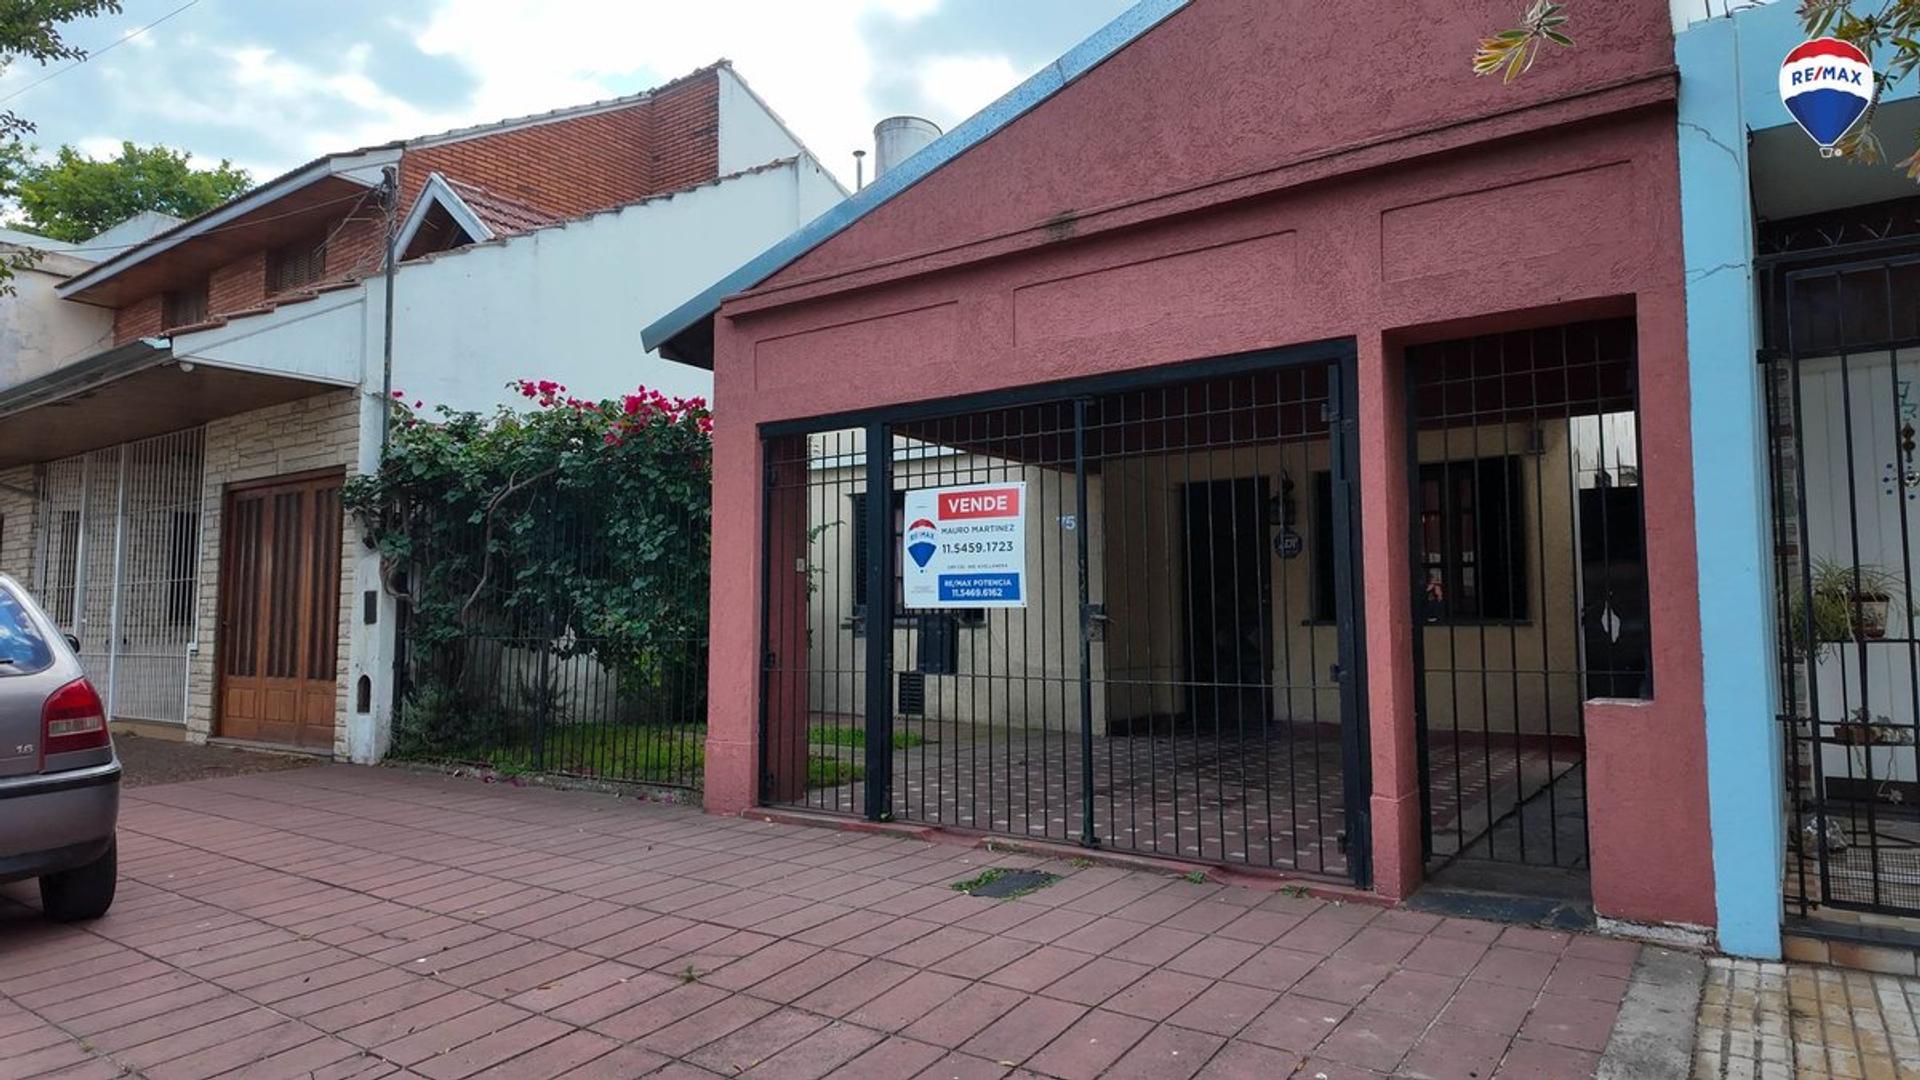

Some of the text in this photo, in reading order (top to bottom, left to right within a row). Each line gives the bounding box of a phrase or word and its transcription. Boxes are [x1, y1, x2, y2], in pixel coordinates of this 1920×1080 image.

[948, 495, 1008, 513] VENDE
[941, 524, 1015, 535] MAURO MARTINEZ
[942, 541, 1014, 554] 11.5459.1723
[944, 579, 1012, 588] RE/MAX POTENCIA
